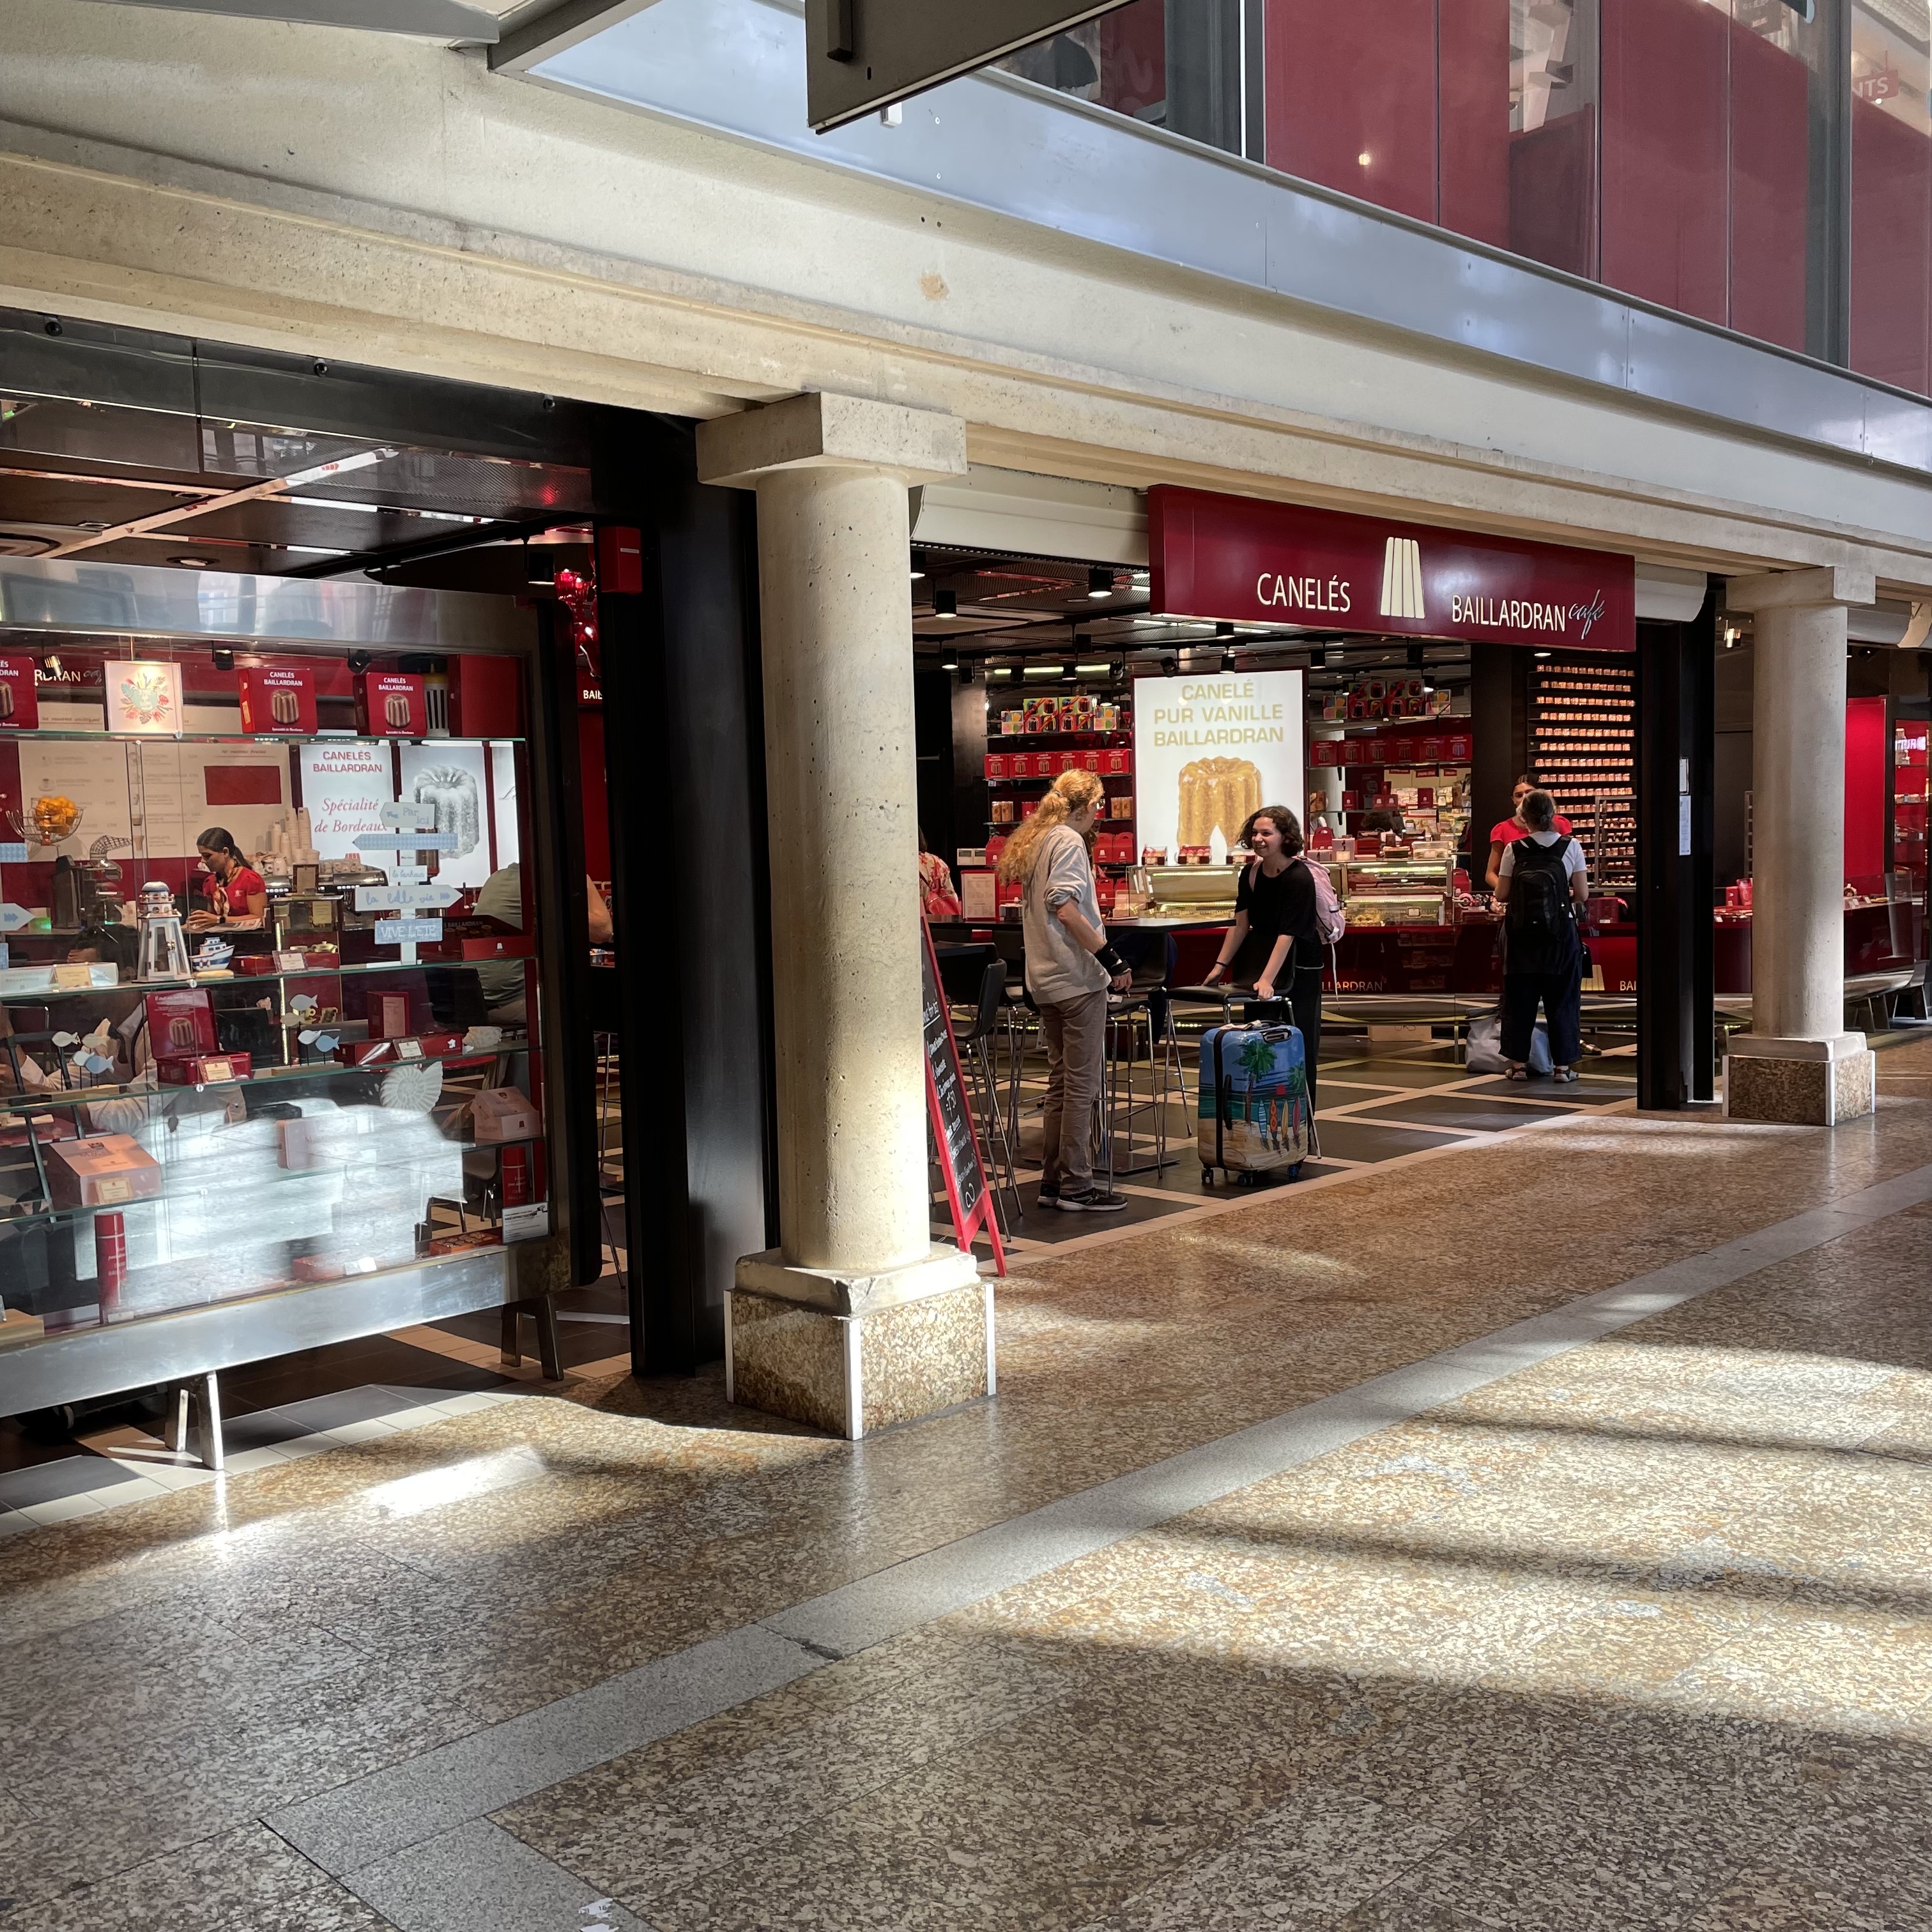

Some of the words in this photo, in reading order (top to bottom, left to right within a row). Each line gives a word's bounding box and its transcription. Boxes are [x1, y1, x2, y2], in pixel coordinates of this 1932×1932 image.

[1257, 573, 1351, 612] CANELÉS
[1452, 594, 1565, 632] BAILLARDRAN
[1568, 589, 1605, 640] café
[1182, 678, 1254, 701] CANELÉ
[1154, 708, 1193, 724] PUR
[1202, 703, 1284, 723] VANILLE
[1154, 726, 1284, 747] BAILLARDRAN
[323, 750, 371, 760] CANELÉS
[313, 763, 382, 772] BAILLARDRAN
[322, 797, 379, 815] Spécialité
[402, 807, 419, 816] Par
[314, 818, 328, 832] de
[332, 818, 387, 832] Bordeaux
[380, 926, 405, 938] VIVE
